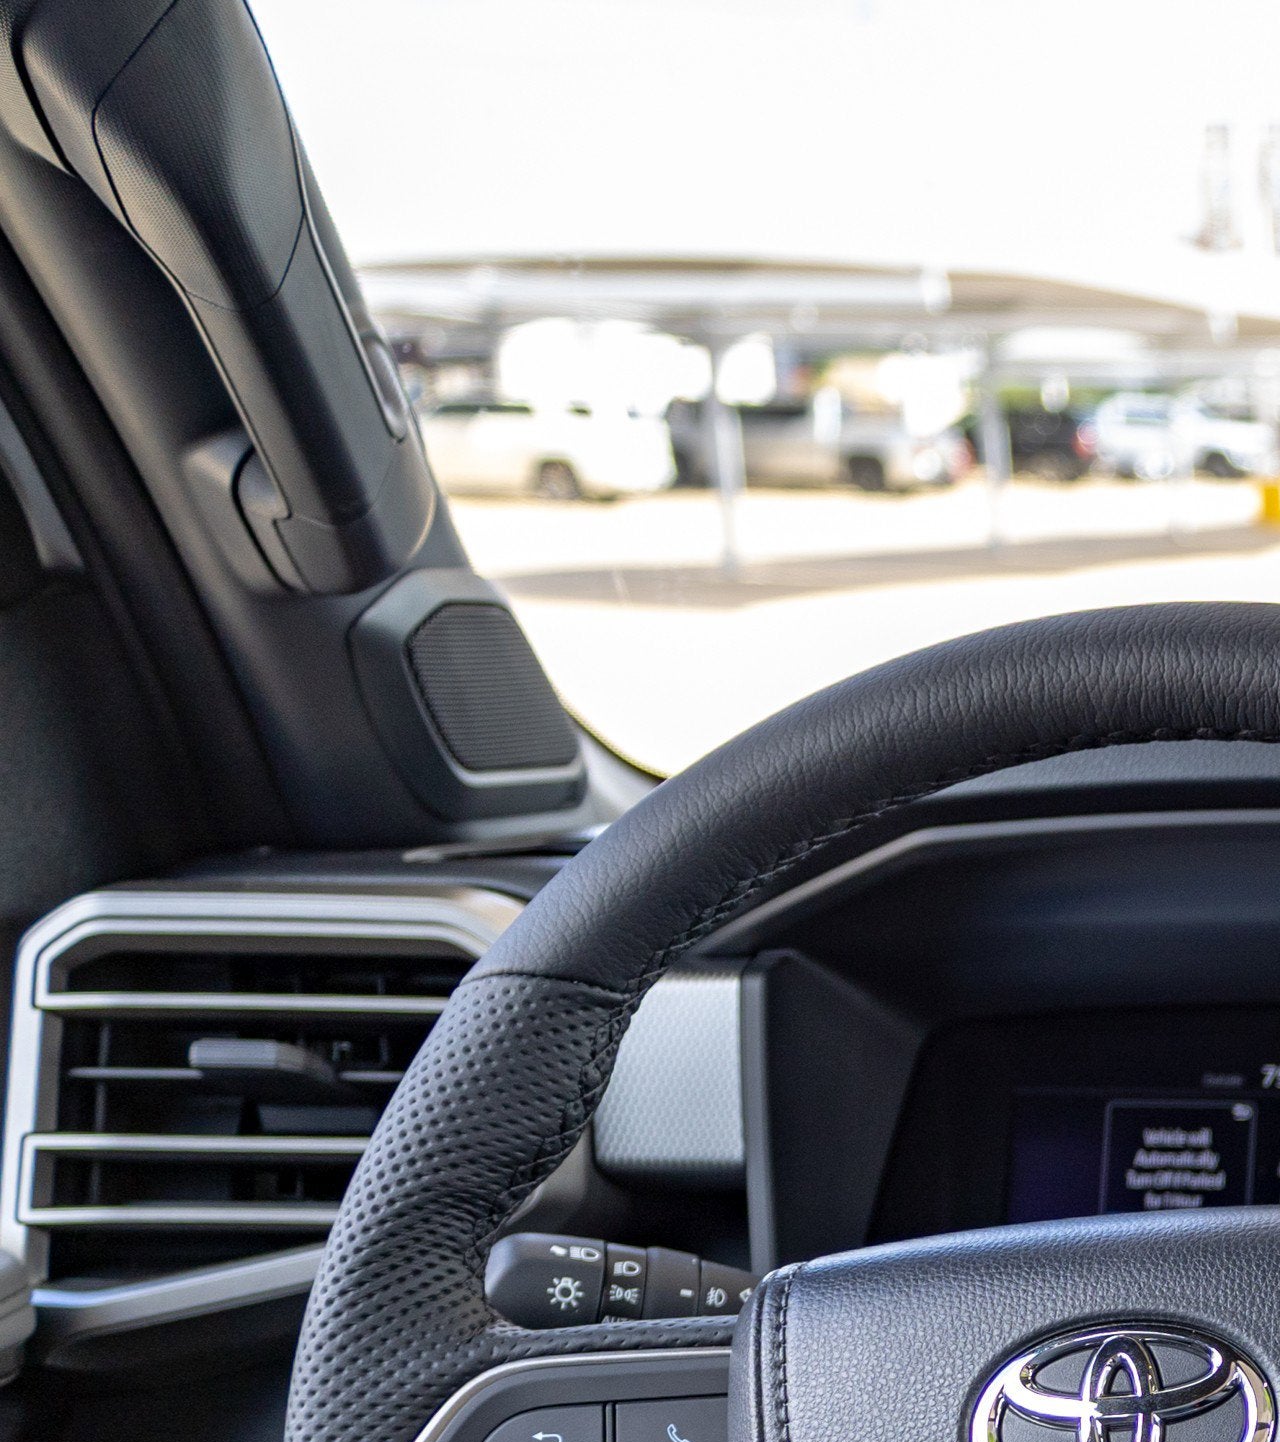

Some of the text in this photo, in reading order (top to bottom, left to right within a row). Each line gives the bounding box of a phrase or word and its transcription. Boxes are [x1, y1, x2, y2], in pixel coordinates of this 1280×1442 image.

[1143, 1127, 1213, 1148] Vehicle will
[1133, 1149, 1220, 1170] Automatically
